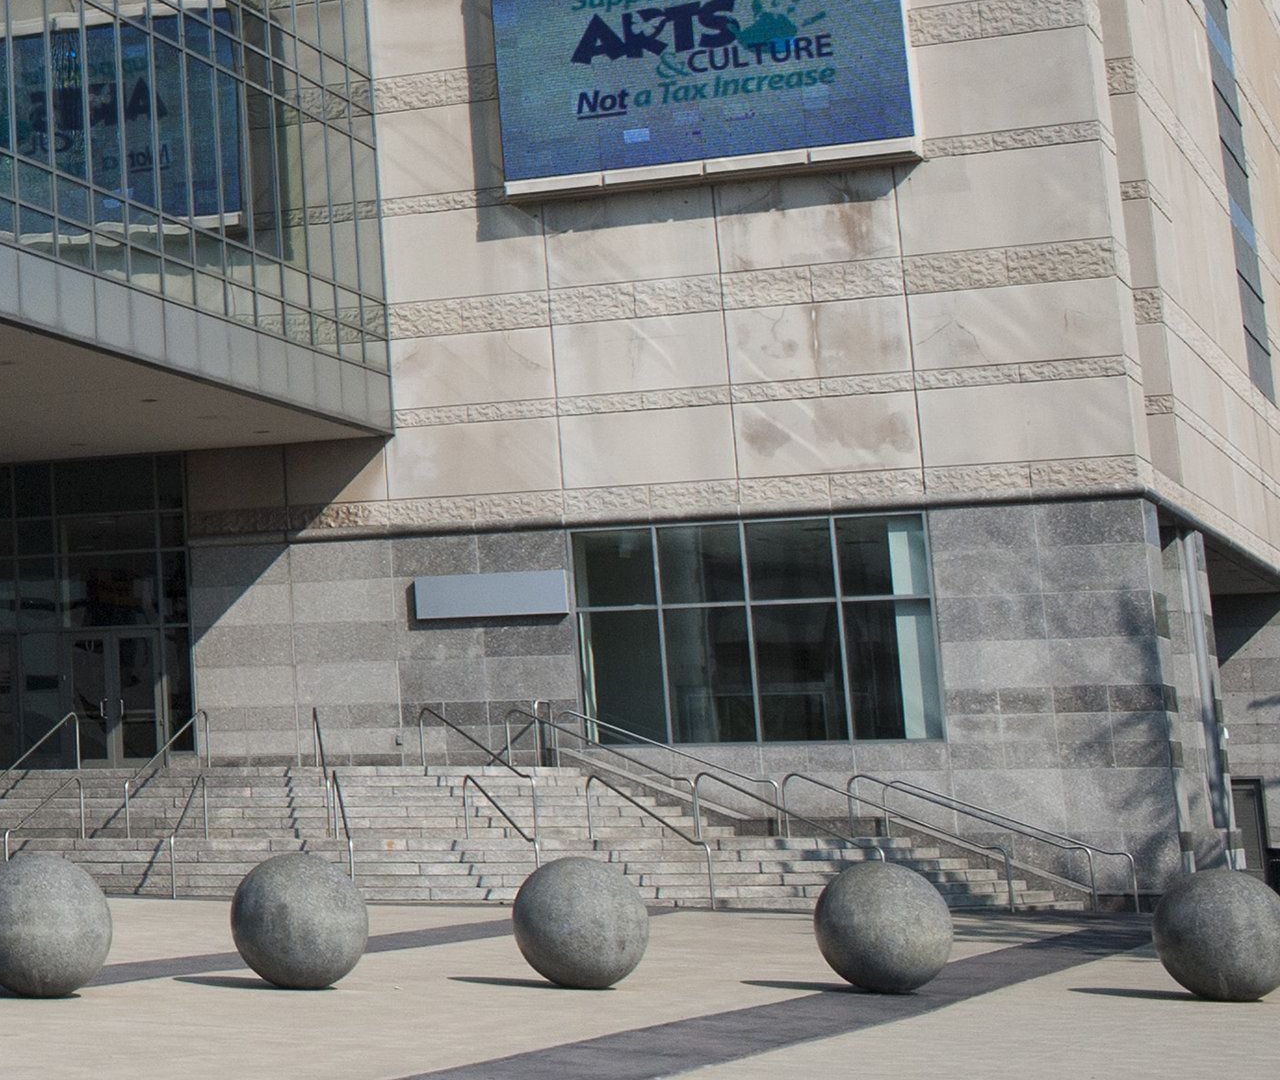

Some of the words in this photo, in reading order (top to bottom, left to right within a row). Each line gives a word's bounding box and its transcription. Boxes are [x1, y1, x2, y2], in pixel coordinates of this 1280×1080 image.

[656, 52, 690, 78] &
[687, 33, 834, 73] CULTURE
[577, 88, 629, 115] Not
[633, 90, 652, 108] a
[657, 81, 707, 105] Tax
[713, 66, 836, 98] Increase
